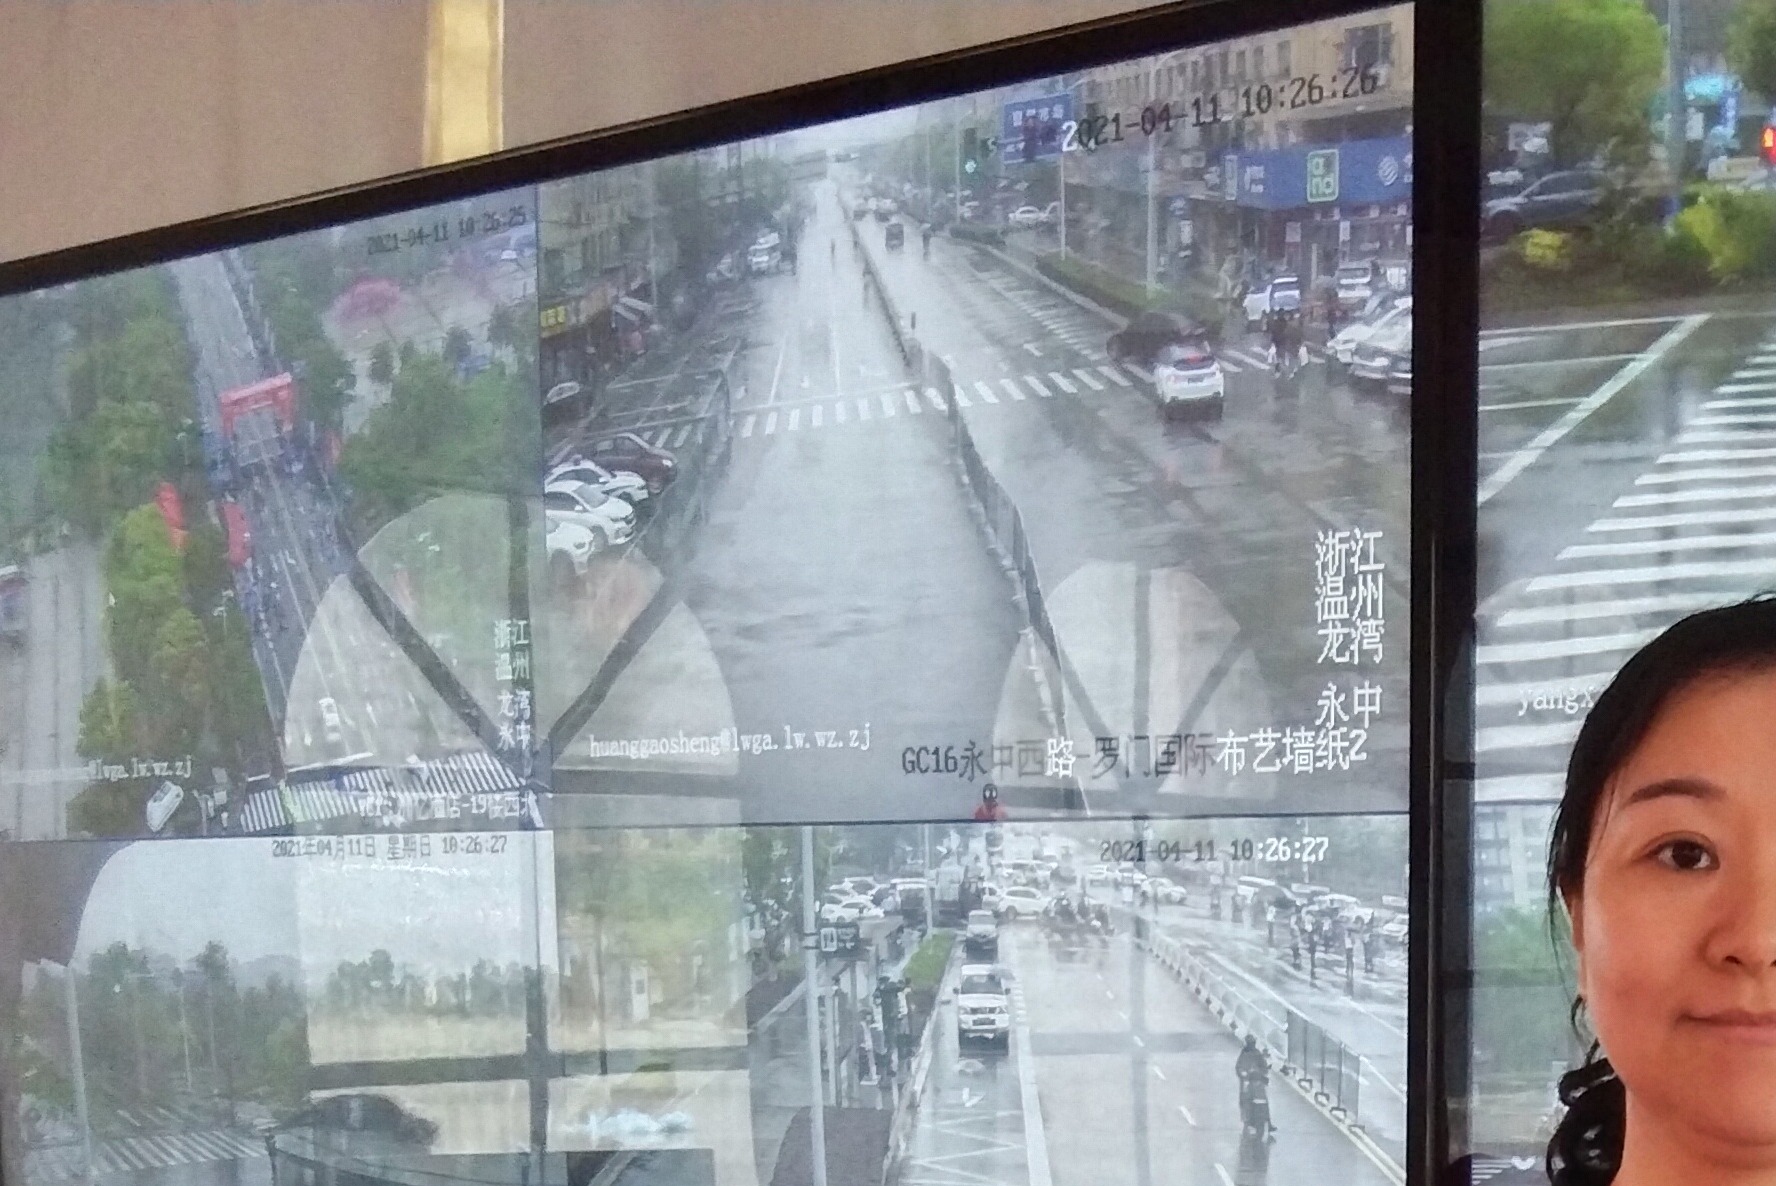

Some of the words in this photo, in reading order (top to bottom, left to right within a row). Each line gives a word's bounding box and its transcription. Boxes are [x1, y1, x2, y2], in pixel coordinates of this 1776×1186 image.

[1062, 95, 1222, 152] 2021-04-11
[1241, 67, 1379, 118] 10:26:26
[1315, 527, 1386, 584] 浙江
[1315, 572, 1384, 624] 温州
[1315, 617, 1385, 665] 龙湾
[1314, 680, 1384, 730] 永中
[441, 834, 508, 855] 10:26:27
[1100, 839, 1218, 863] 2021-04-11
[1230, 836, 1329, 863] 10:26:27
